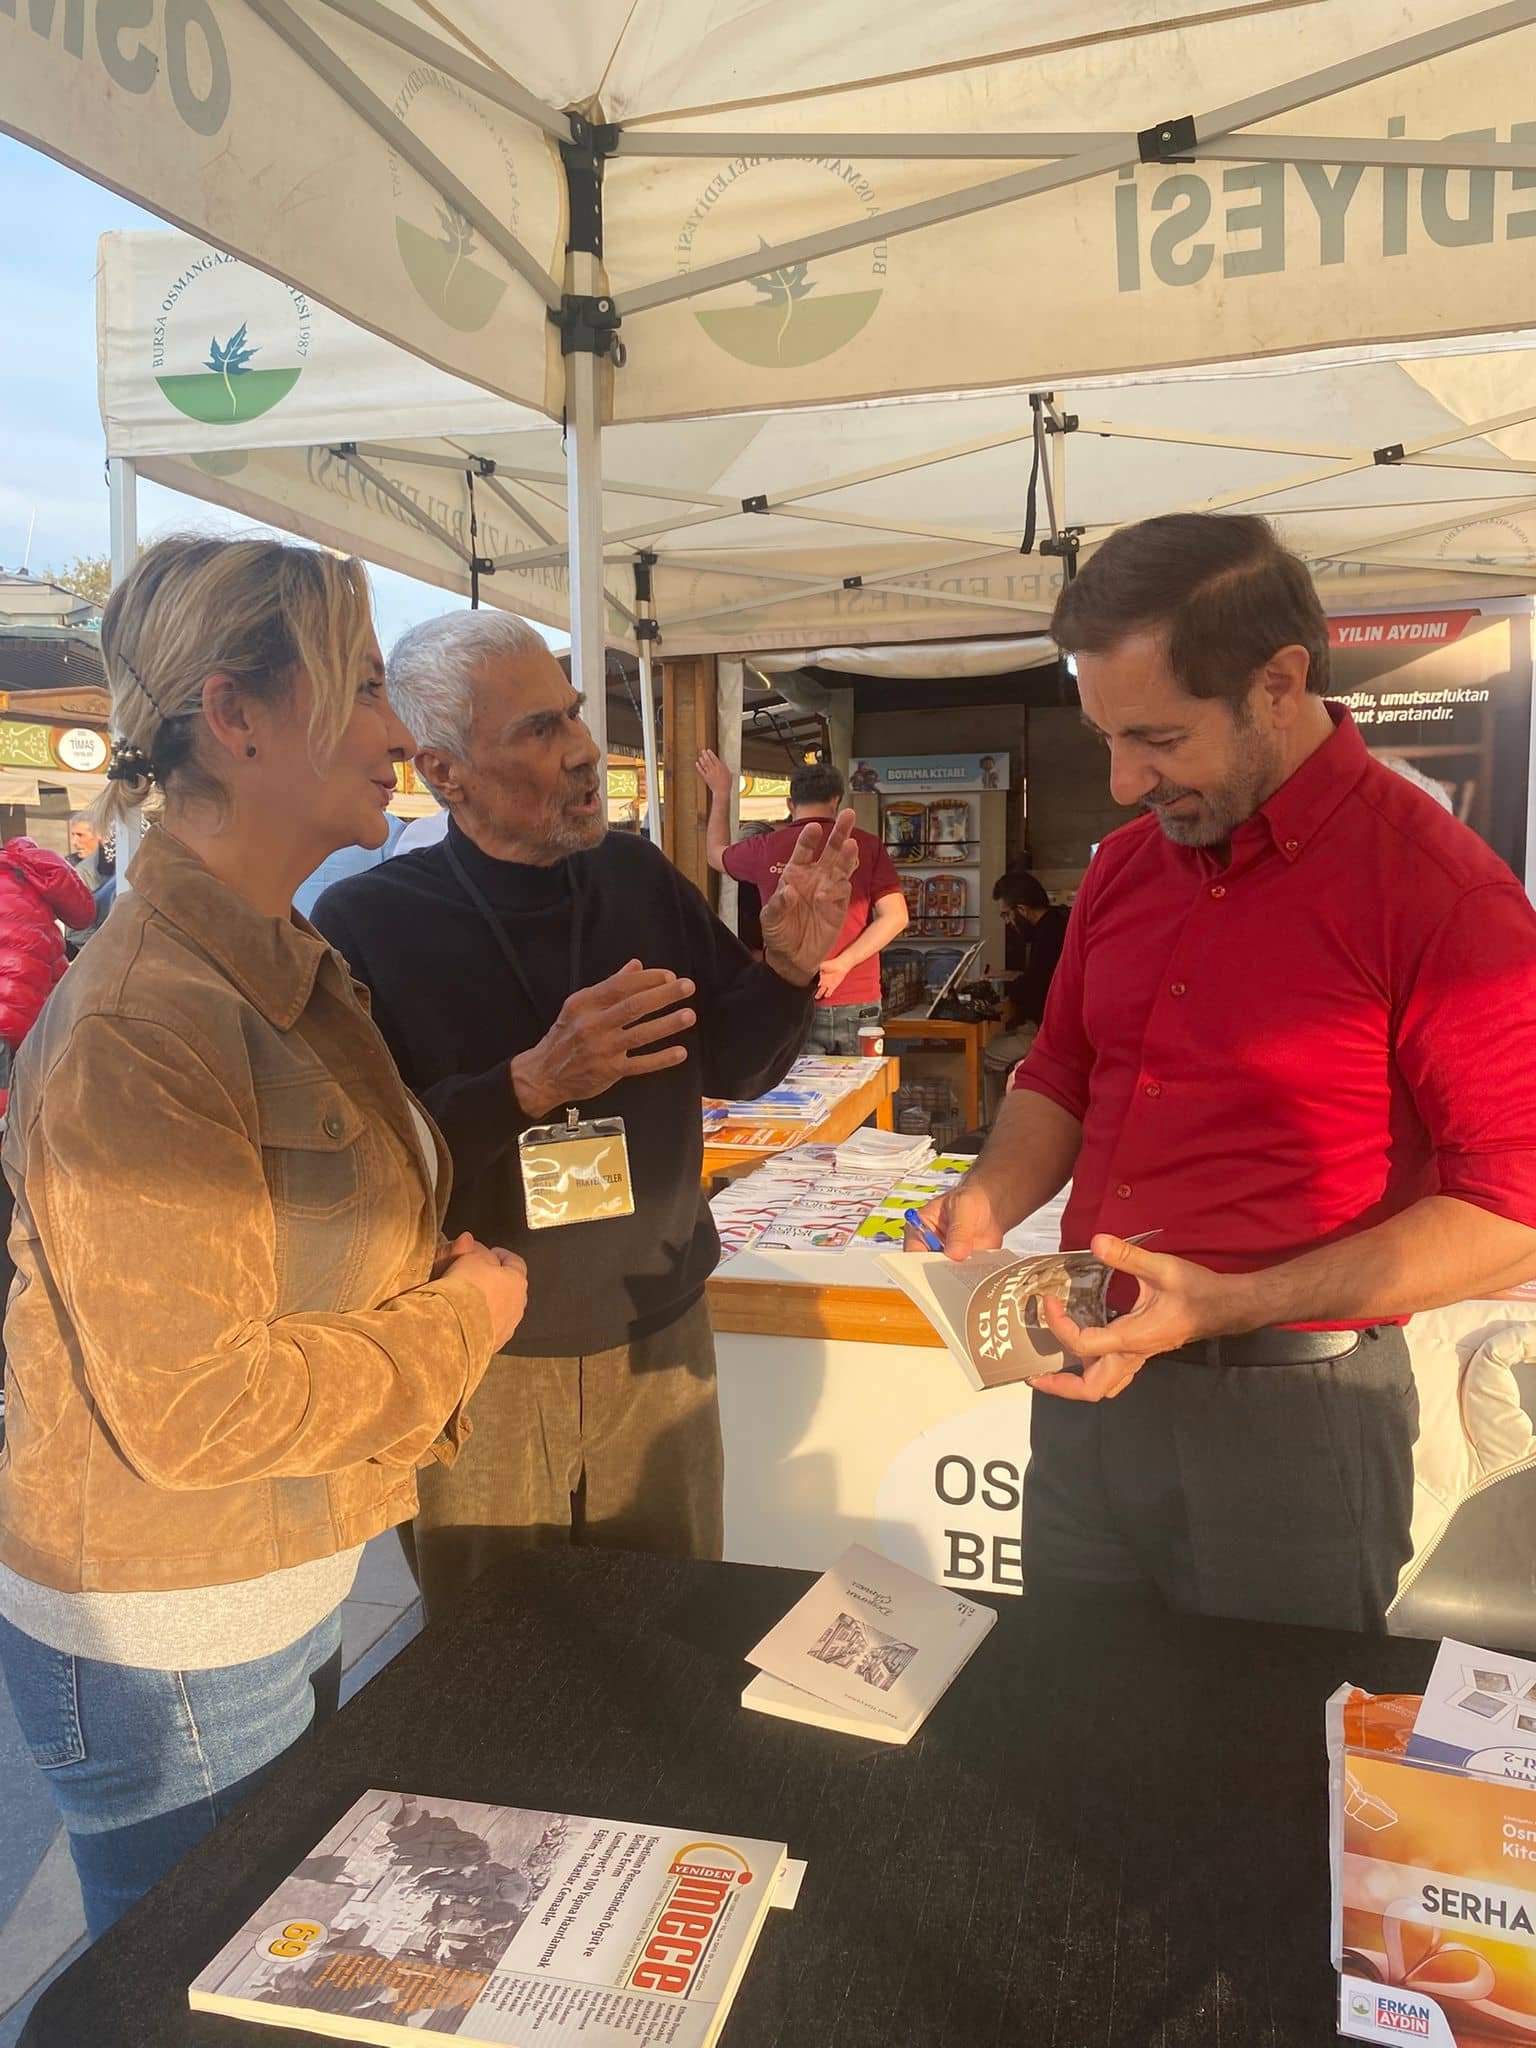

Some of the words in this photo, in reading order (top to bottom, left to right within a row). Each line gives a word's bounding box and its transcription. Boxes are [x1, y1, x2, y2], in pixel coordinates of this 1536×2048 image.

[152, 316, 168, 368] BURSA
[297, 326, 311, 357] 1987
[1337, 625, 1383, 643] YILIN
[1386, 622, 1448, 640] AYDINI
[1380, 689, 1489, 708] umutsuzluktan
[1351, 709, 1375, 724] mut
[1376, 707, 1454, 724] yaratandır.
[887, 769, 930, 780] BOYAMA
[978, 1310, 999, 1361] Acı
[935, 1454, 1020, 1511] OS
[944, 1529, 1022, 1587] BE
[584, 1828, 609, 1851] Eğitim,
[622, 1833, 646, 1857] Birlikte
[631, 1835, 660, 1868] Yönetimin
[561, 1852, 594, 1887] Tarikatlar,
[611, 1857, 632, 1877] Evrim
[673, 1864, 735, 1882] YENİDEN
[582, 1877, 598, 1890] 100
[601, 1868, 641, 1921] Penceresinden
[538, 1887, 572, 1926] Cemaatler
[564, 1890, 590, 1915] Yaşına
[1421, 1884, 1536, 1936] SERHA
[263, 1922, 325, 1959] 69
[535, 1915, 576, 1968] Hazırlanmak
[586, 1921, 613, 1945] Örgüt
[581, 1946, 595, 1957] ve
[1378, 1997, 1430, 2019] ERKAN
[1380, 2012, 1428, 2033] AYDIN
